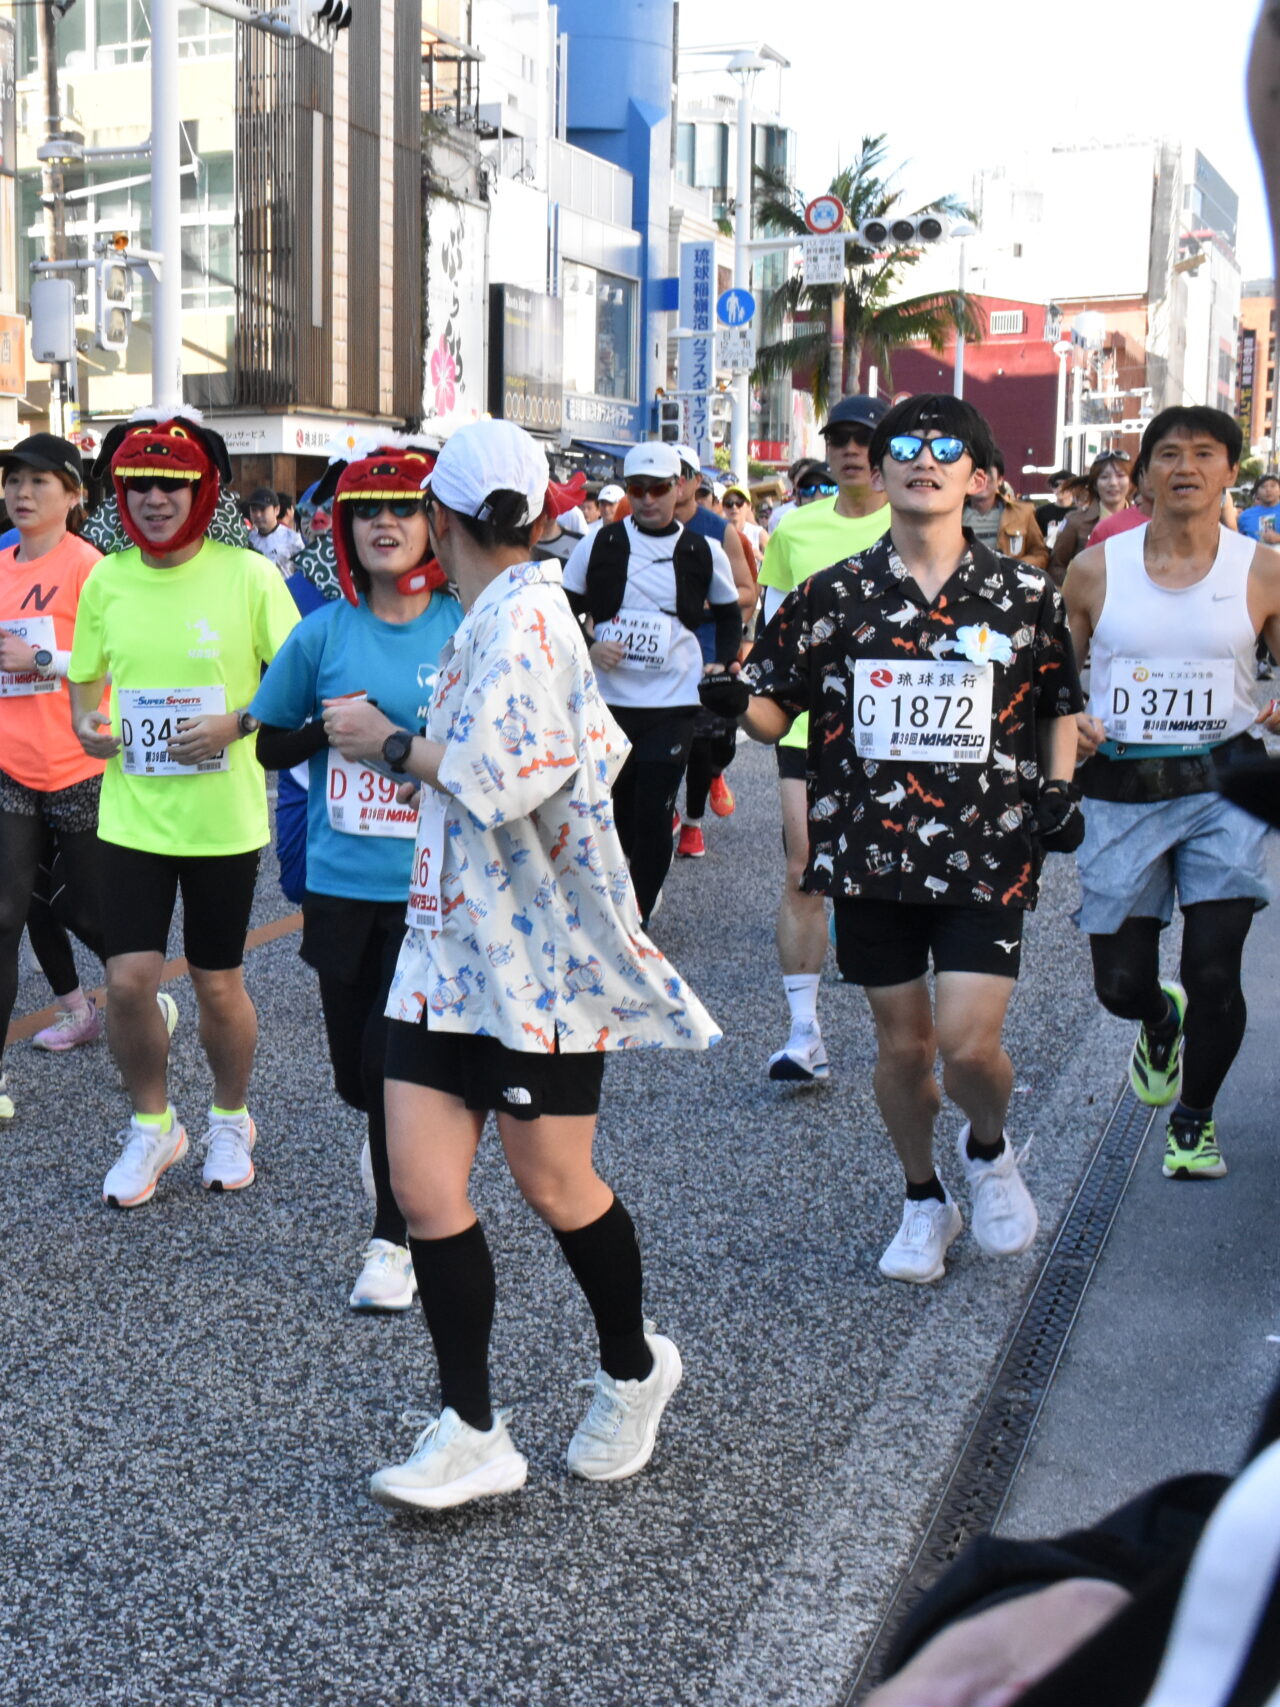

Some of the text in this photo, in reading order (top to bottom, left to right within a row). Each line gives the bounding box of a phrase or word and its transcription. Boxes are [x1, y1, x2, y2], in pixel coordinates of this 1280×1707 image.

[897, 671, 977, 689] 琉球銀行
[857, 694, 974, 729] C 1872
[1113, 687, 1213, 717] D 3711
[122, 718, 133, 747] D
[890, 731, 985, 747] 第39回 NAHAマラソン
[330, 767, 347, 800] D
